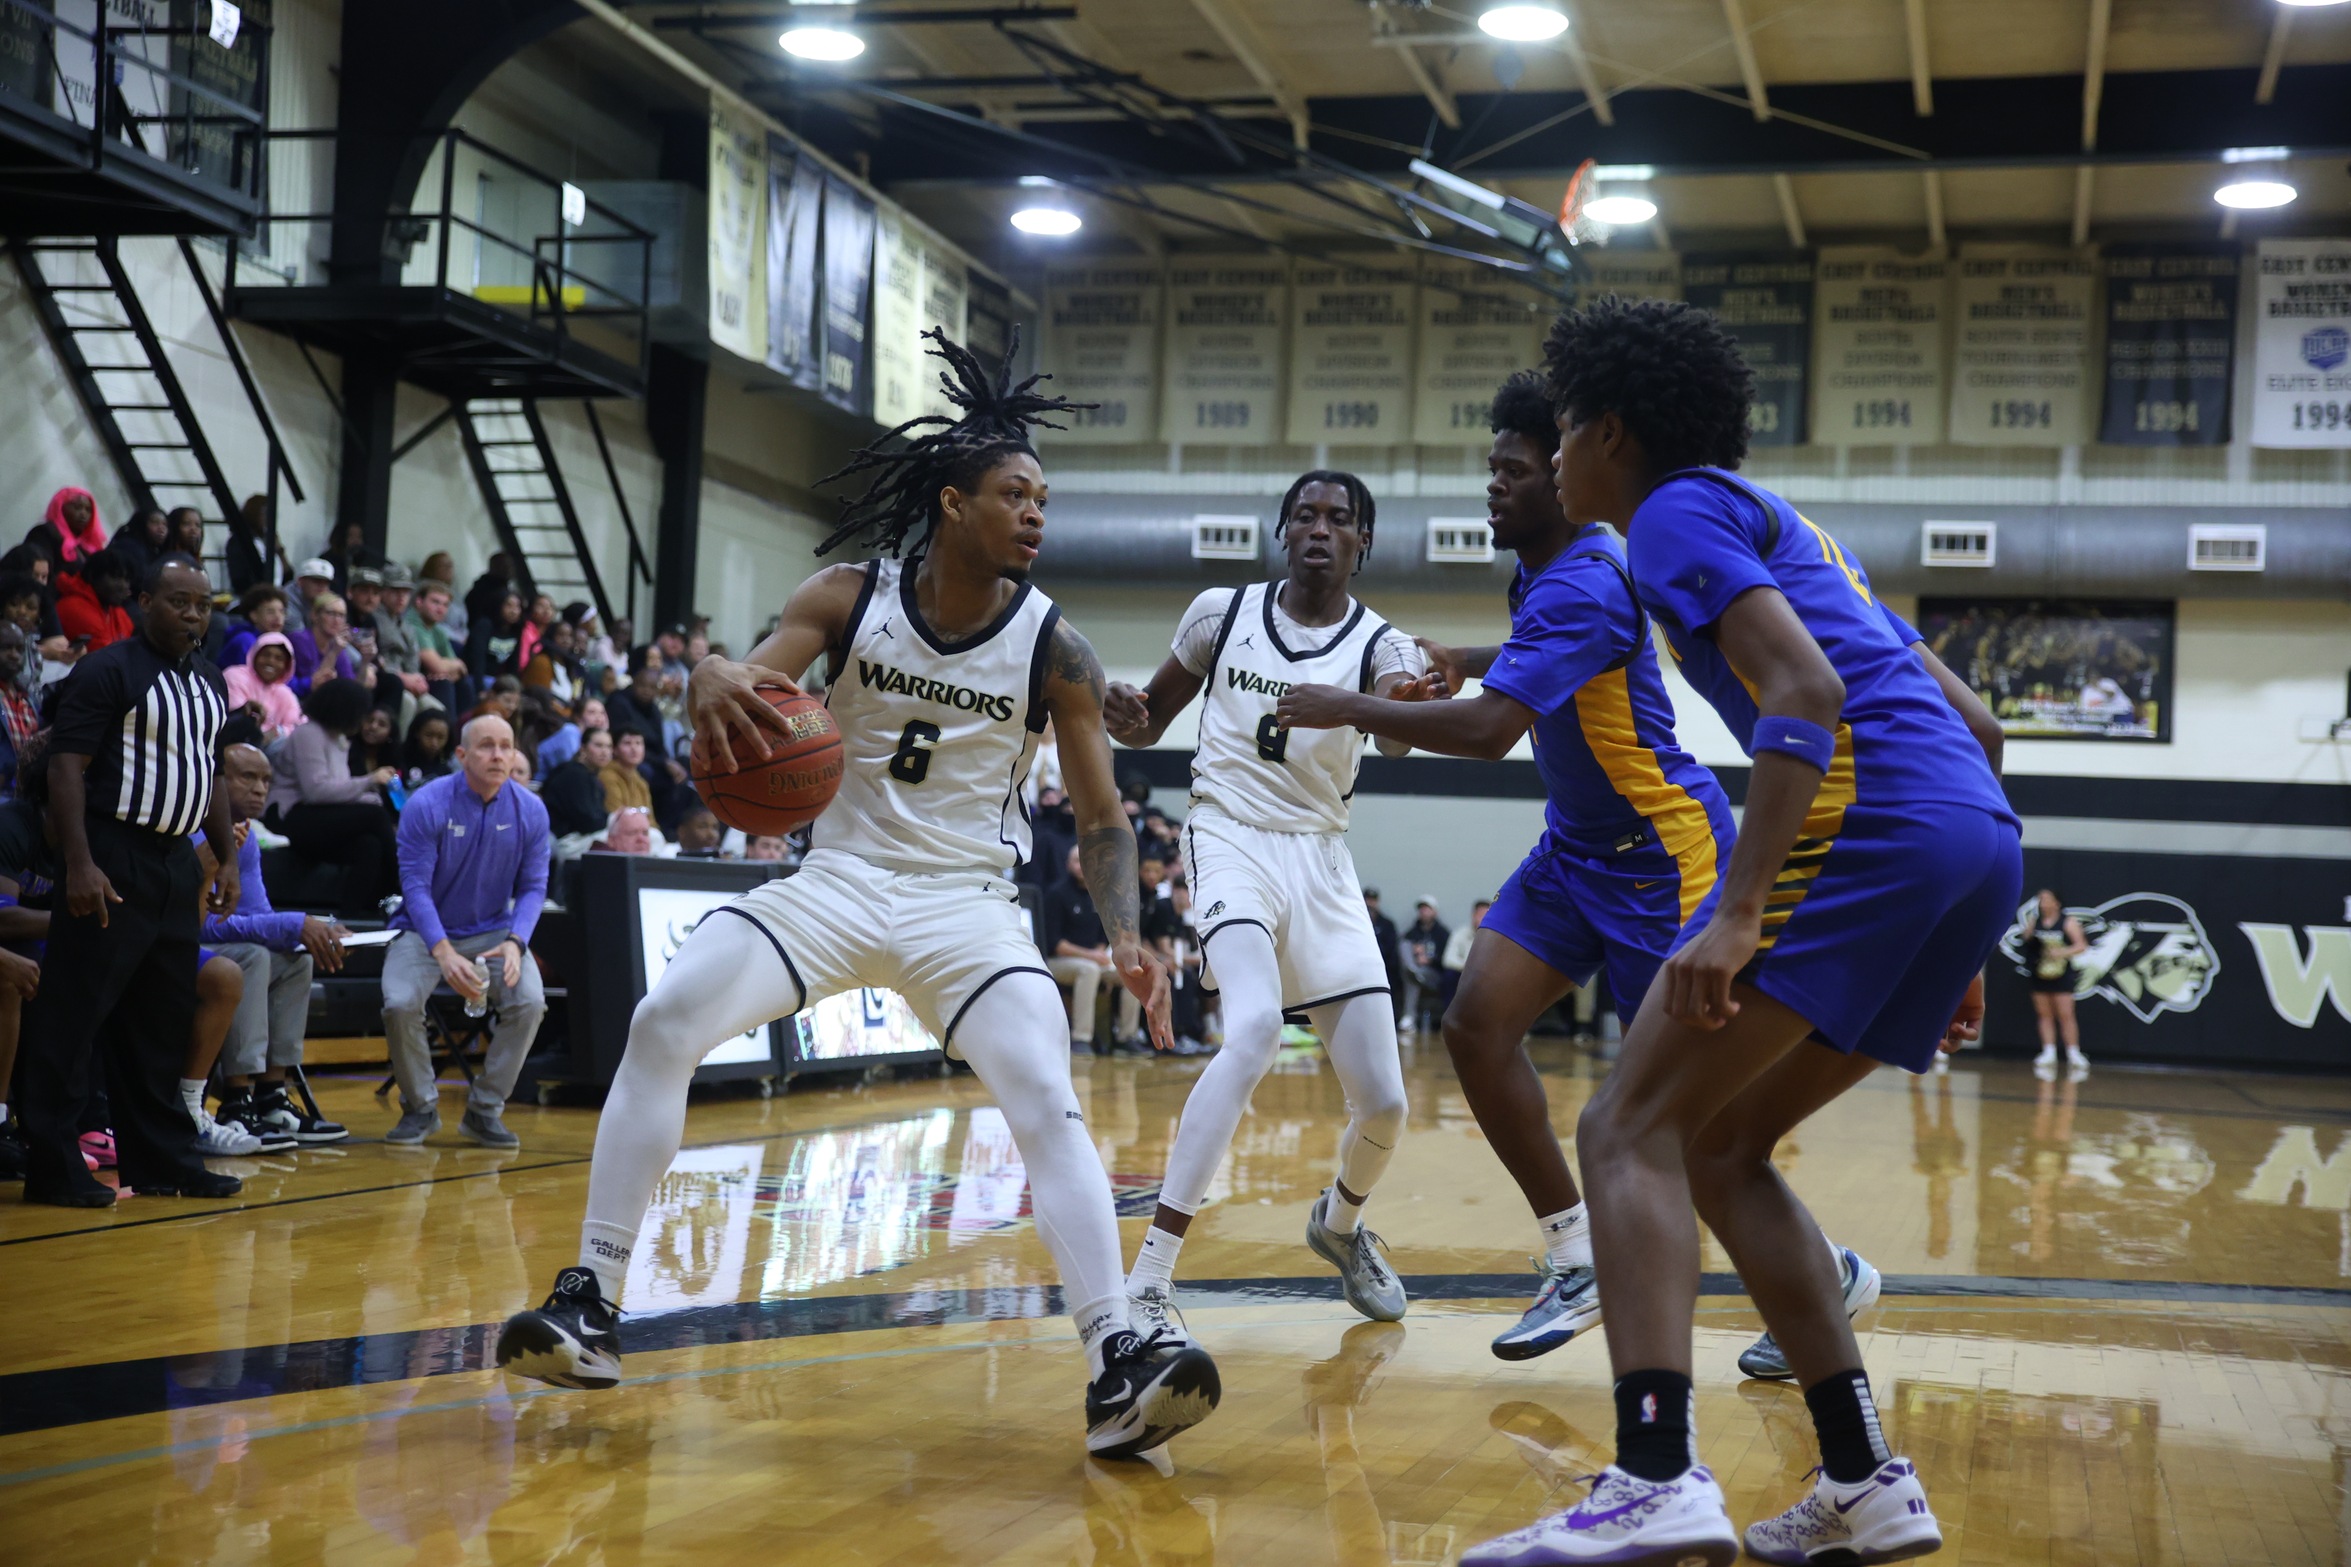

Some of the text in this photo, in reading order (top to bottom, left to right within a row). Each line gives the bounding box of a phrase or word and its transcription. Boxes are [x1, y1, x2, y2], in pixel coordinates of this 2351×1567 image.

[858, 659, 1015, 722] WARRIORS
[1227, 667, 1298, 698] WARR
[888, 718, 942, 785] 6
[1256, 712, 1291, 763] 9
[596, 1246, 626, 1264] DEPT
